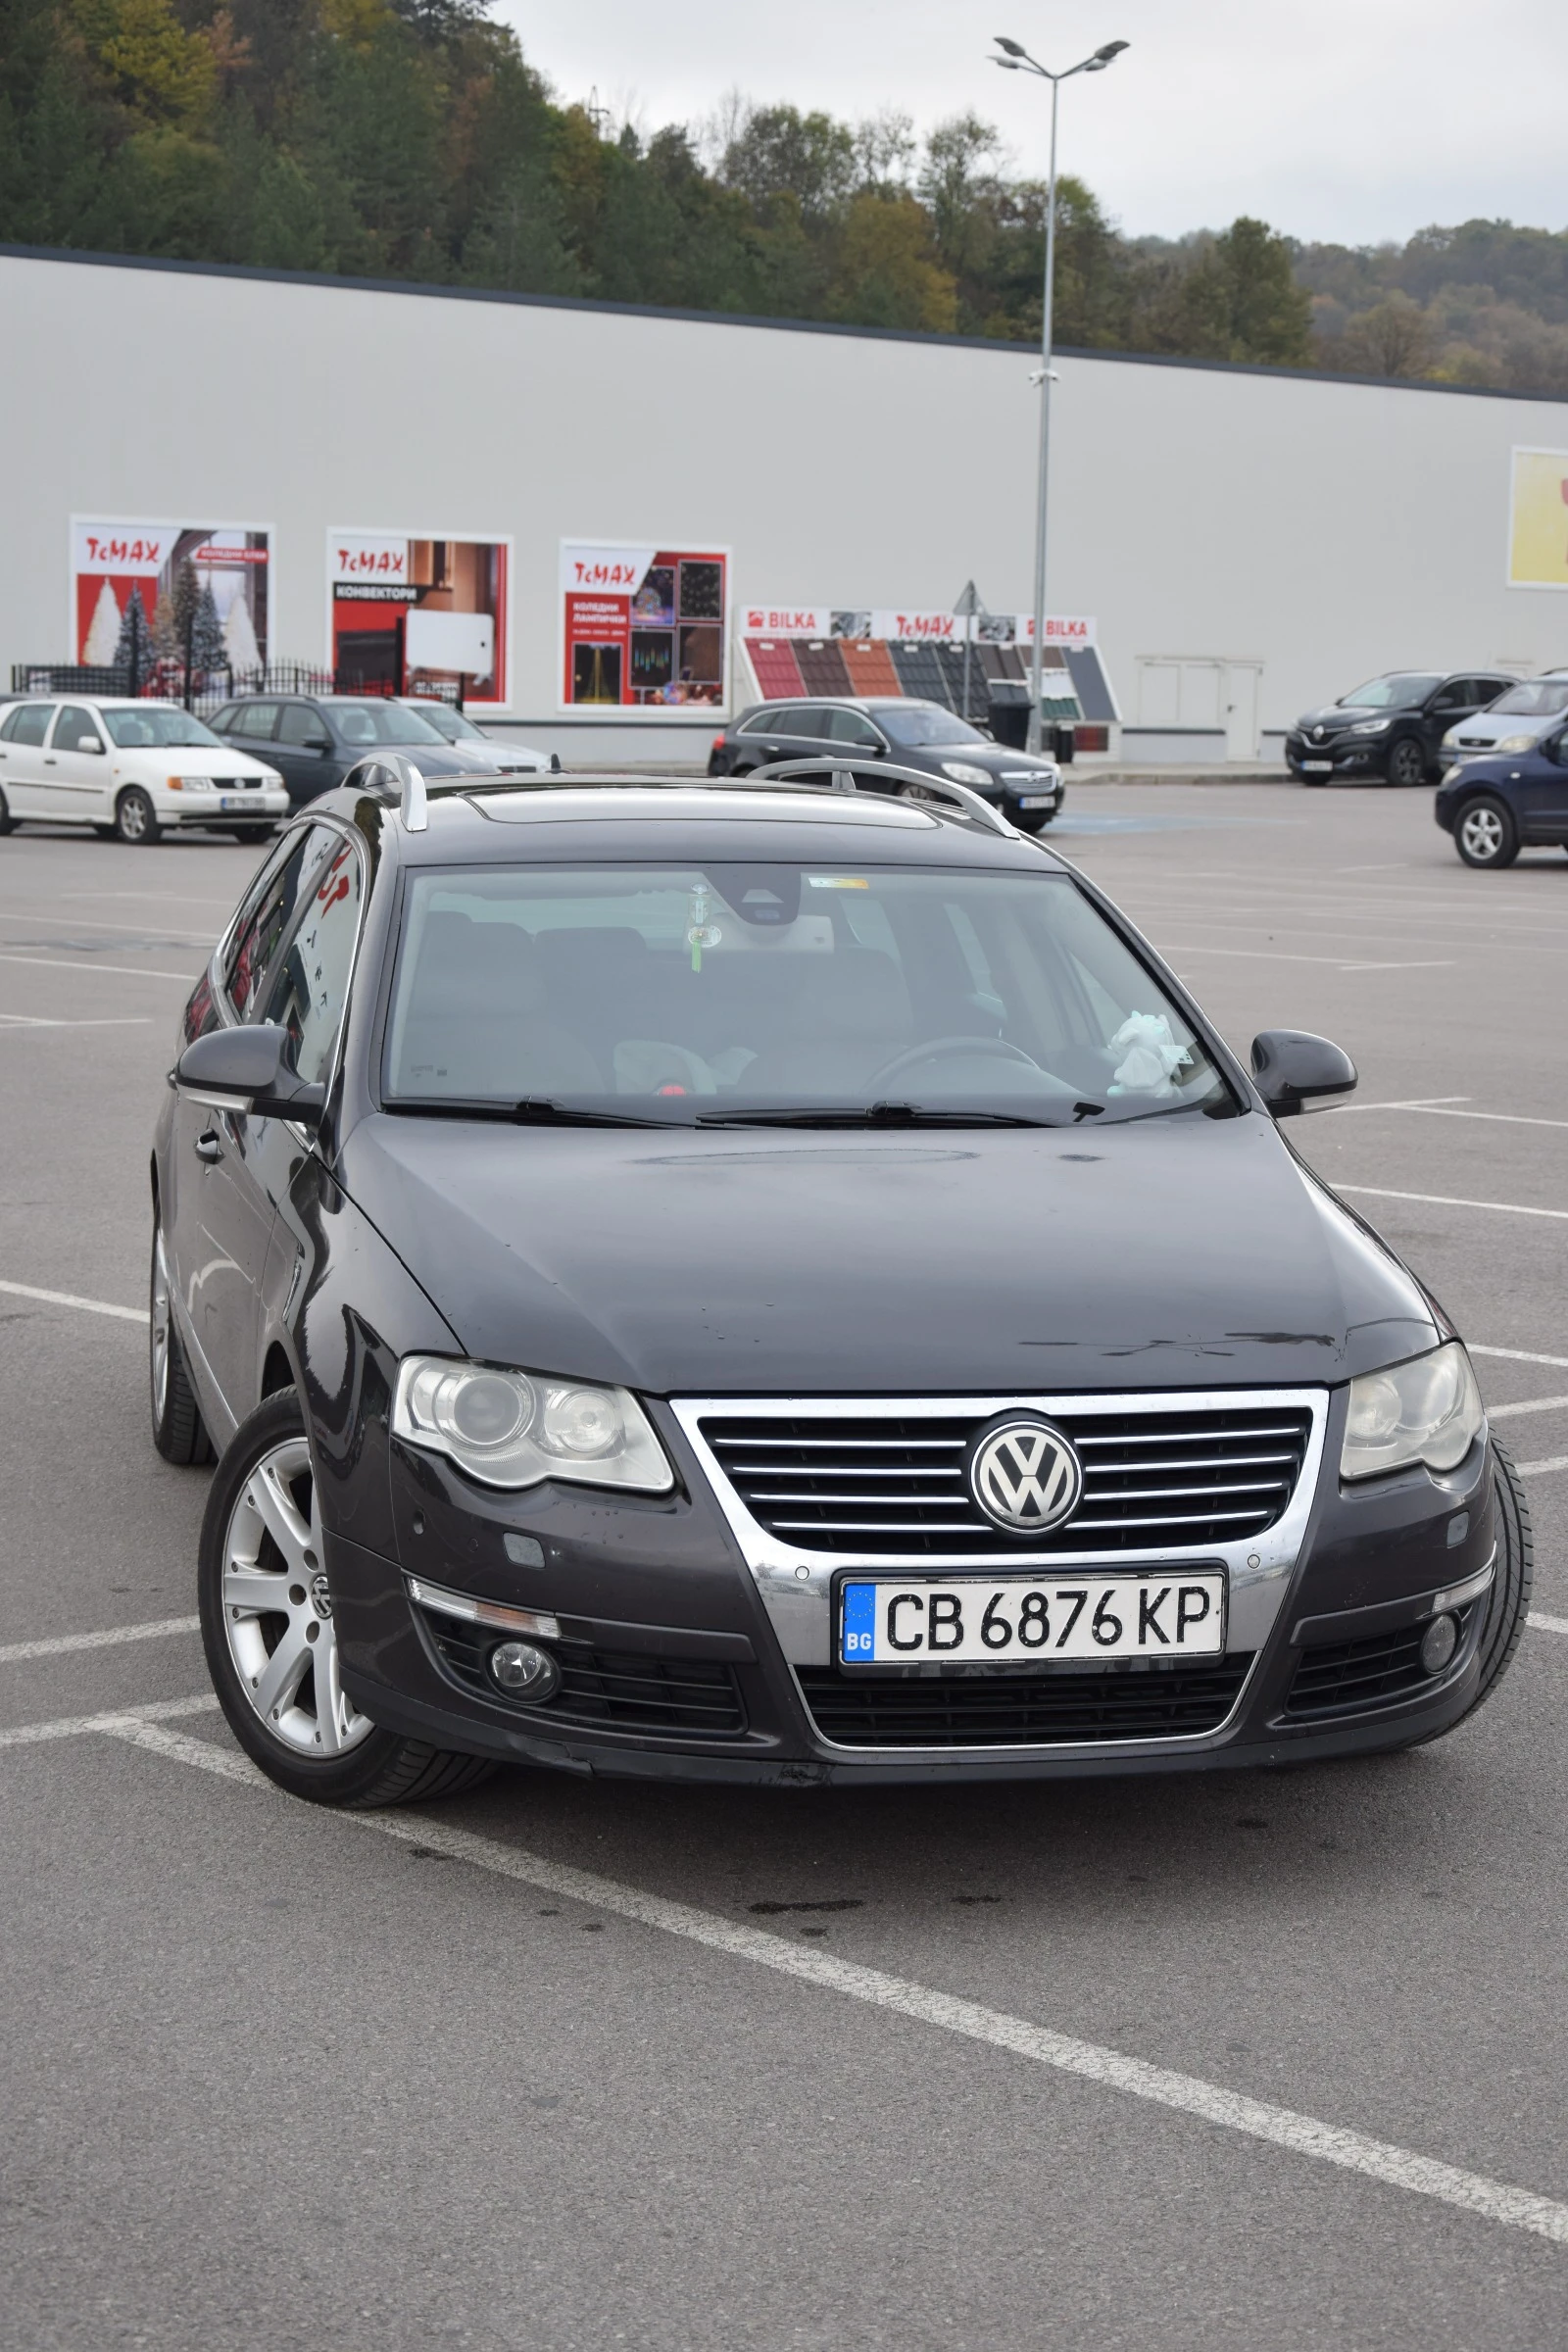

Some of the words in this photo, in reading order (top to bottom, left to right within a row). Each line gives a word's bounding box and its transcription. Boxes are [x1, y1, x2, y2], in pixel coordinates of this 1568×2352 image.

[336, 585, 417, 601] КОНВЕКТОРИ
[769, 612, 816, 629] BILKA
[1046, 620, 1088, 636] BILKA
[886, 1592, 964, 1651] CB
[980, 1589, 1123, 1649] 6876
[1137, 1585, 1210, 1645] KP
[847, 1633, 872, 1650] BG
